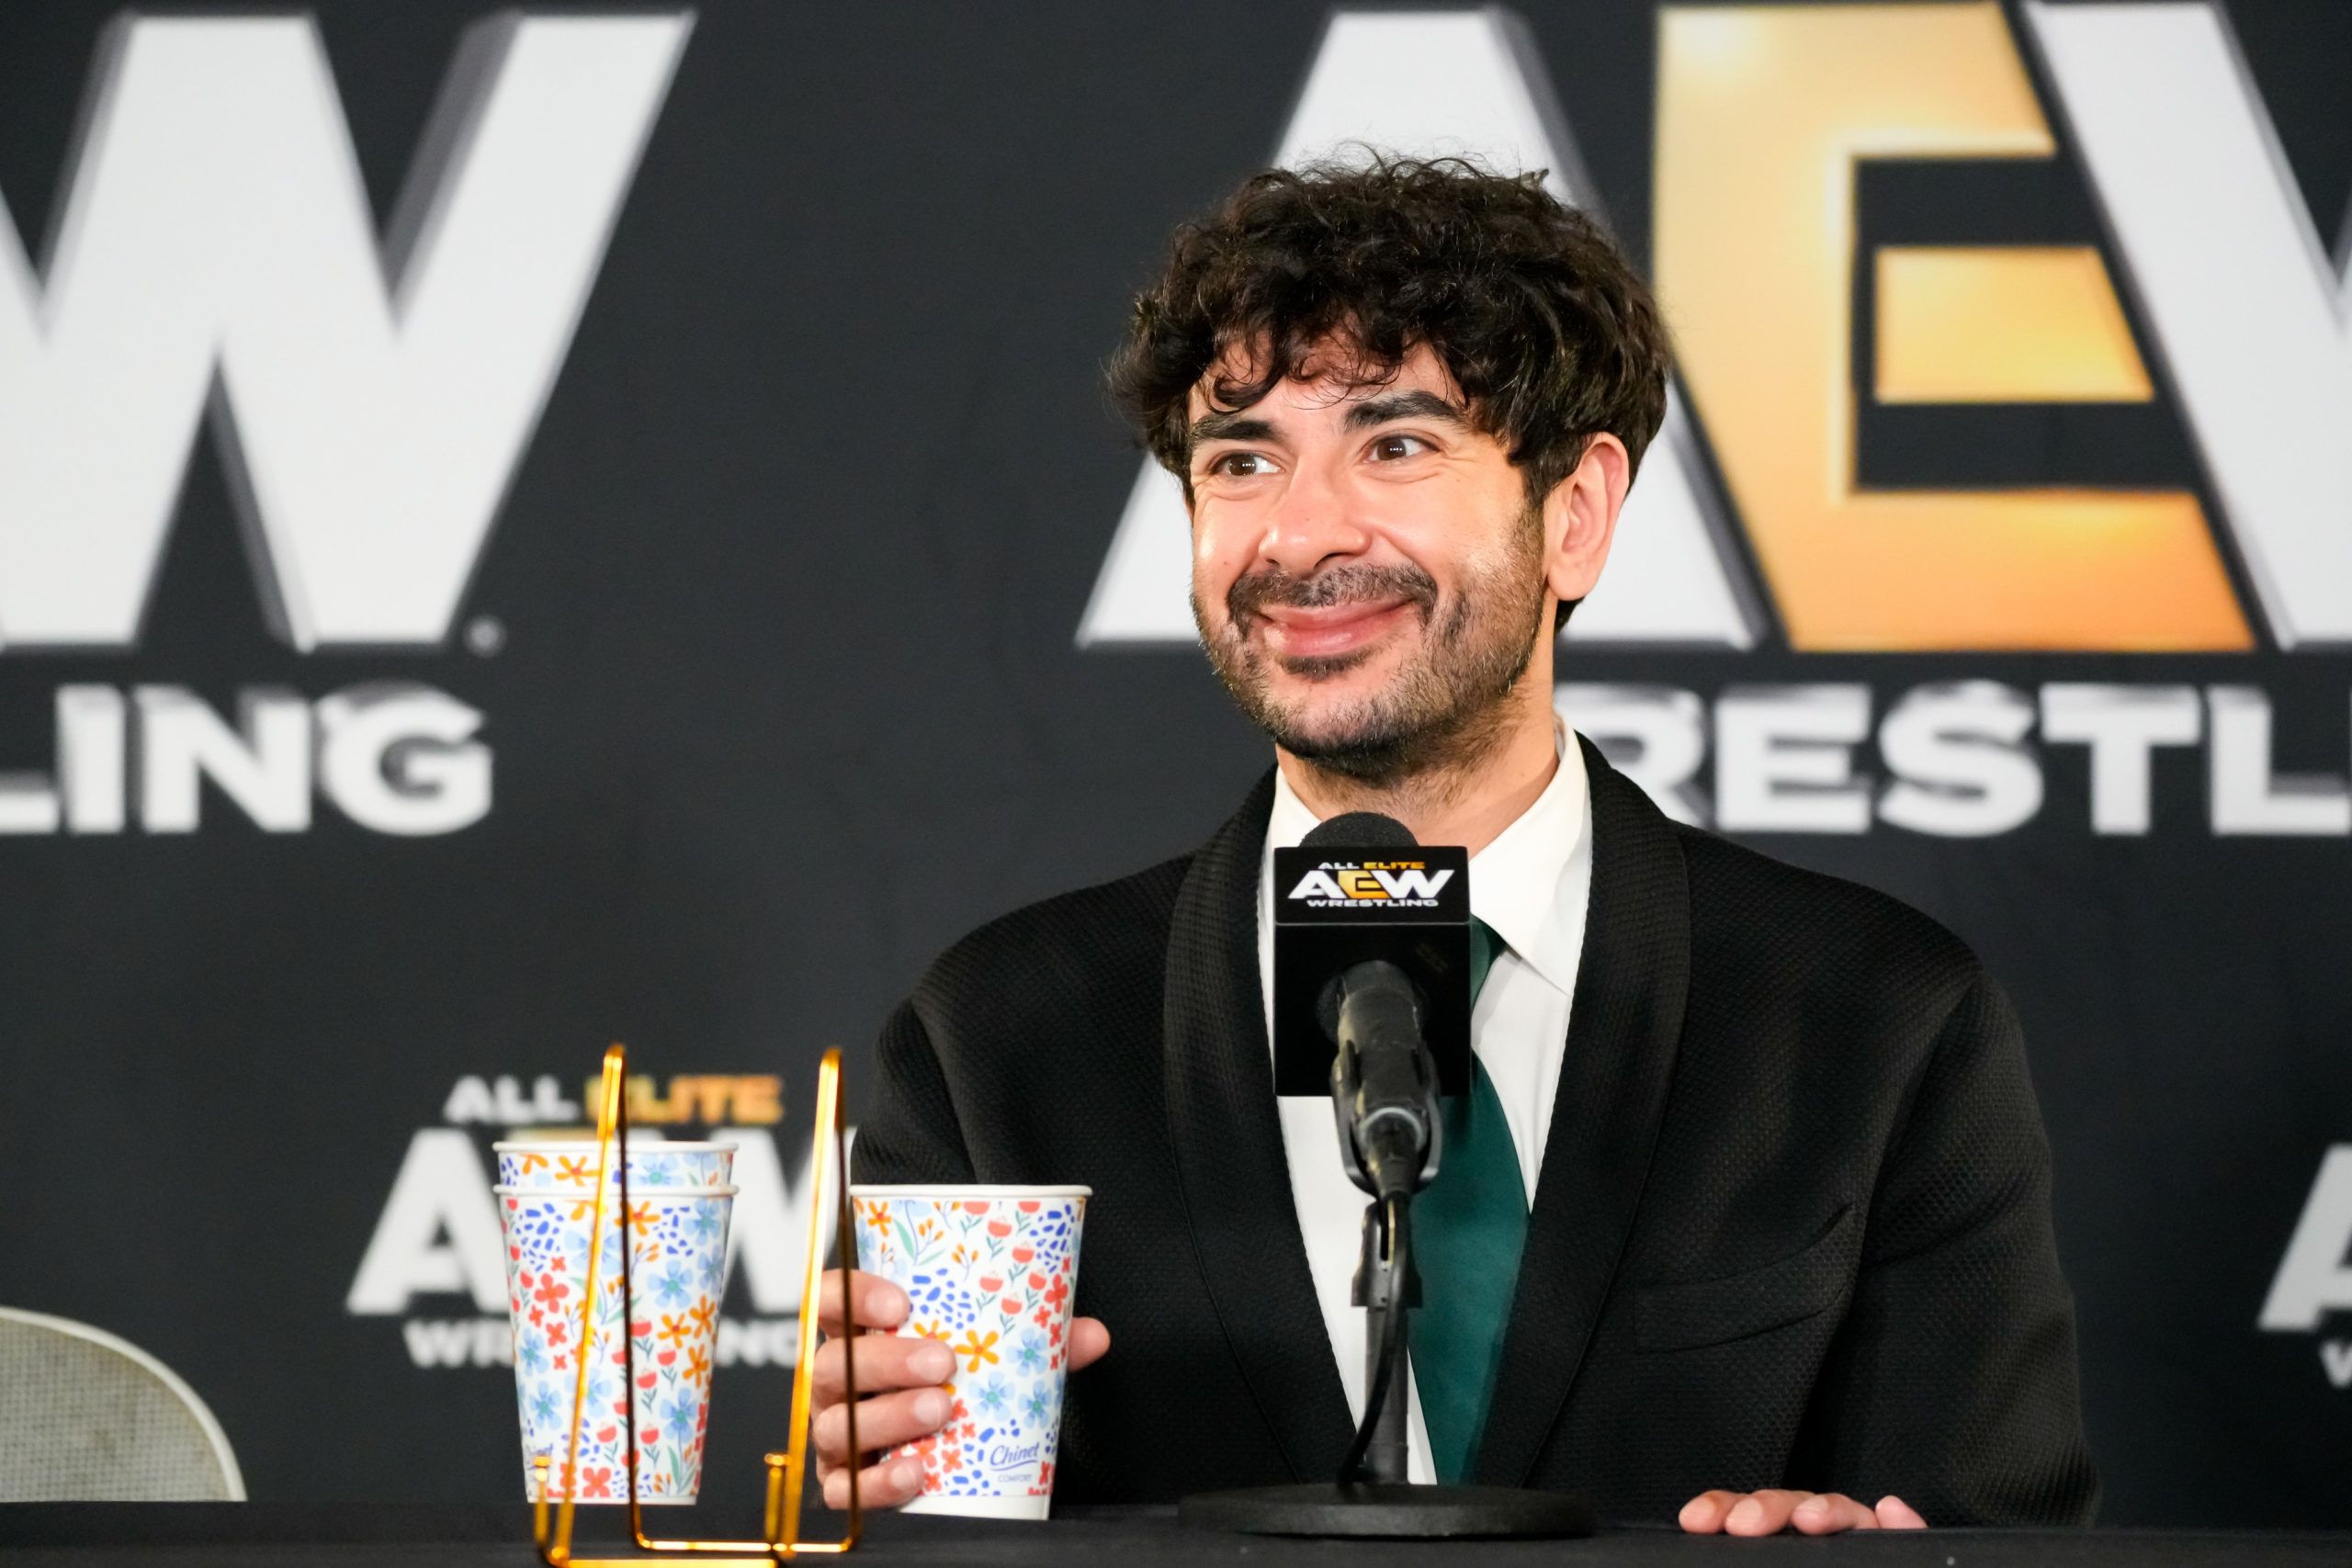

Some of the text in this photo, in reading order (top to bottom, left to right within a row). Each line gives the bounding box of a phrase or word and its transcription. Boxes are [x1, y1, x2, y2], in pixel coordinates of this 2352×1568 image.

[1318, 862, 1426, 870] ALL ELITE
[1288, 870, 1454, 899] AEW
[1306, 899, 1439, 908] WRESTLING
[444, 1076, 578, 1123] ALL
[989, 1441, 1040, 1467] Chinet
